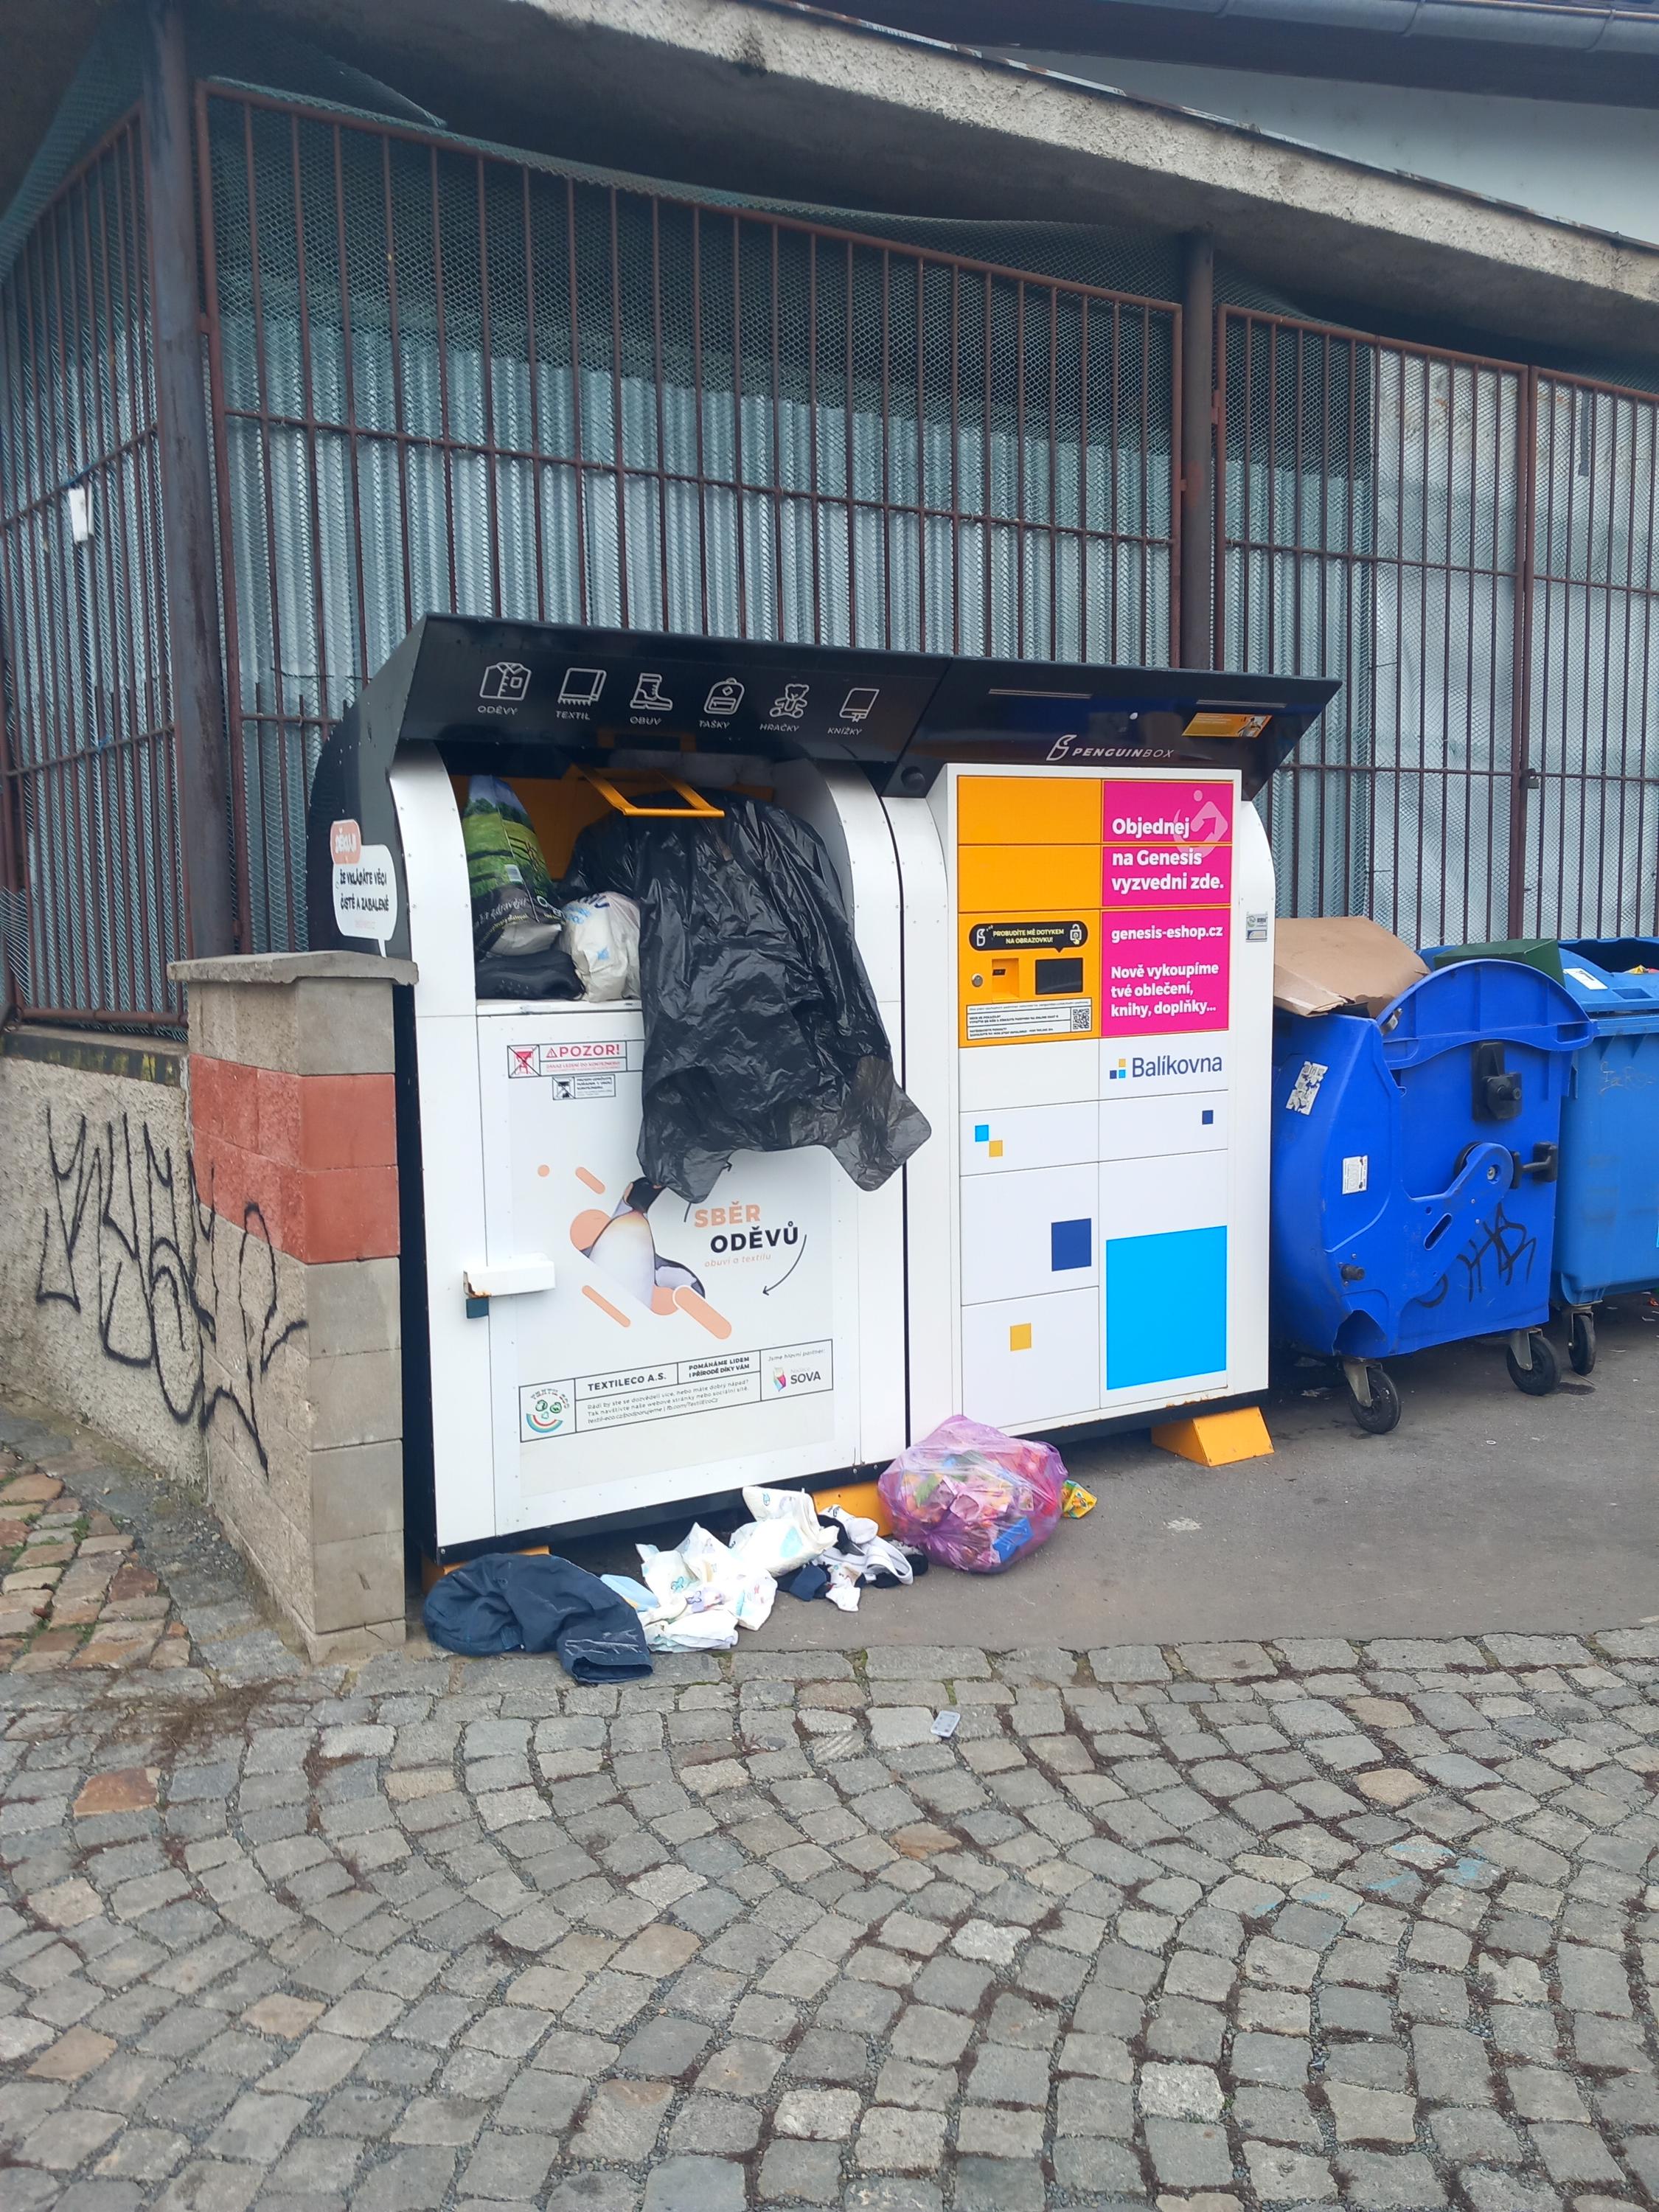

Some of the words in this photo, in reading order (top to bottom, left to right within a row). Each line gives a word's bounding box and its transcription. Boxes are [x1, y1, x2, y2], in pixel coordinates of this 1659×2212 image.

[477, 704, 518, 716] ODĚVY
[555, 710, 591, 720] TEXTIL
[630, 716, 661, 726] OBUV
[699, 719, 730, 730] TAŠKY
[759, 723, 799, 732] HRAČKY
[827, 726, 863, 736] KNÍŽKY
[1072, 747, 1175, 758] PENGUINBOX
[1112, 816, 1189, 838] Objednej
[1112, 852, 1133, 866] na
[1137, 847, 1202, 866] Genesis
[1111, 872, 1187, 894] vyzvedni
[1190, 872, 1224, 889] zde.
[356, 897, 361, 910] A
[1111, 925, 1223, 944] genesis-eshop.cz
[1110, 964, 1144, 979] Nově
[1147, 961, 1219, 980] vykoupíme
[1110, 984, 1133, 998] tvé
[1134, 981, 1194, 997] oblečení,
[1110, 1002, 1152, 1018] knihy,
[1153, 999, 1217, 1017] doplňky...
[560, 1044, 619, 1057] POZOR!
[1132, 1054, 1222, 1078] Balíkovna
[694, 1200, 761, 1228] SBĚR
[710, 1220, 798, 1253] ODĚVŮ
[704, 1256, 731, 1267] obuvi
[742, 1253, 771, 1263] textilu
[729, 1356, 750, 1365] LIDEM
[736, 1363, 750, 1371] VÁM
[588, 1376, 645, 1391] TEXTILECO
[647, 1372, 667, 1382] A.S.
[790, 1371, 821, 1385] SOVA
